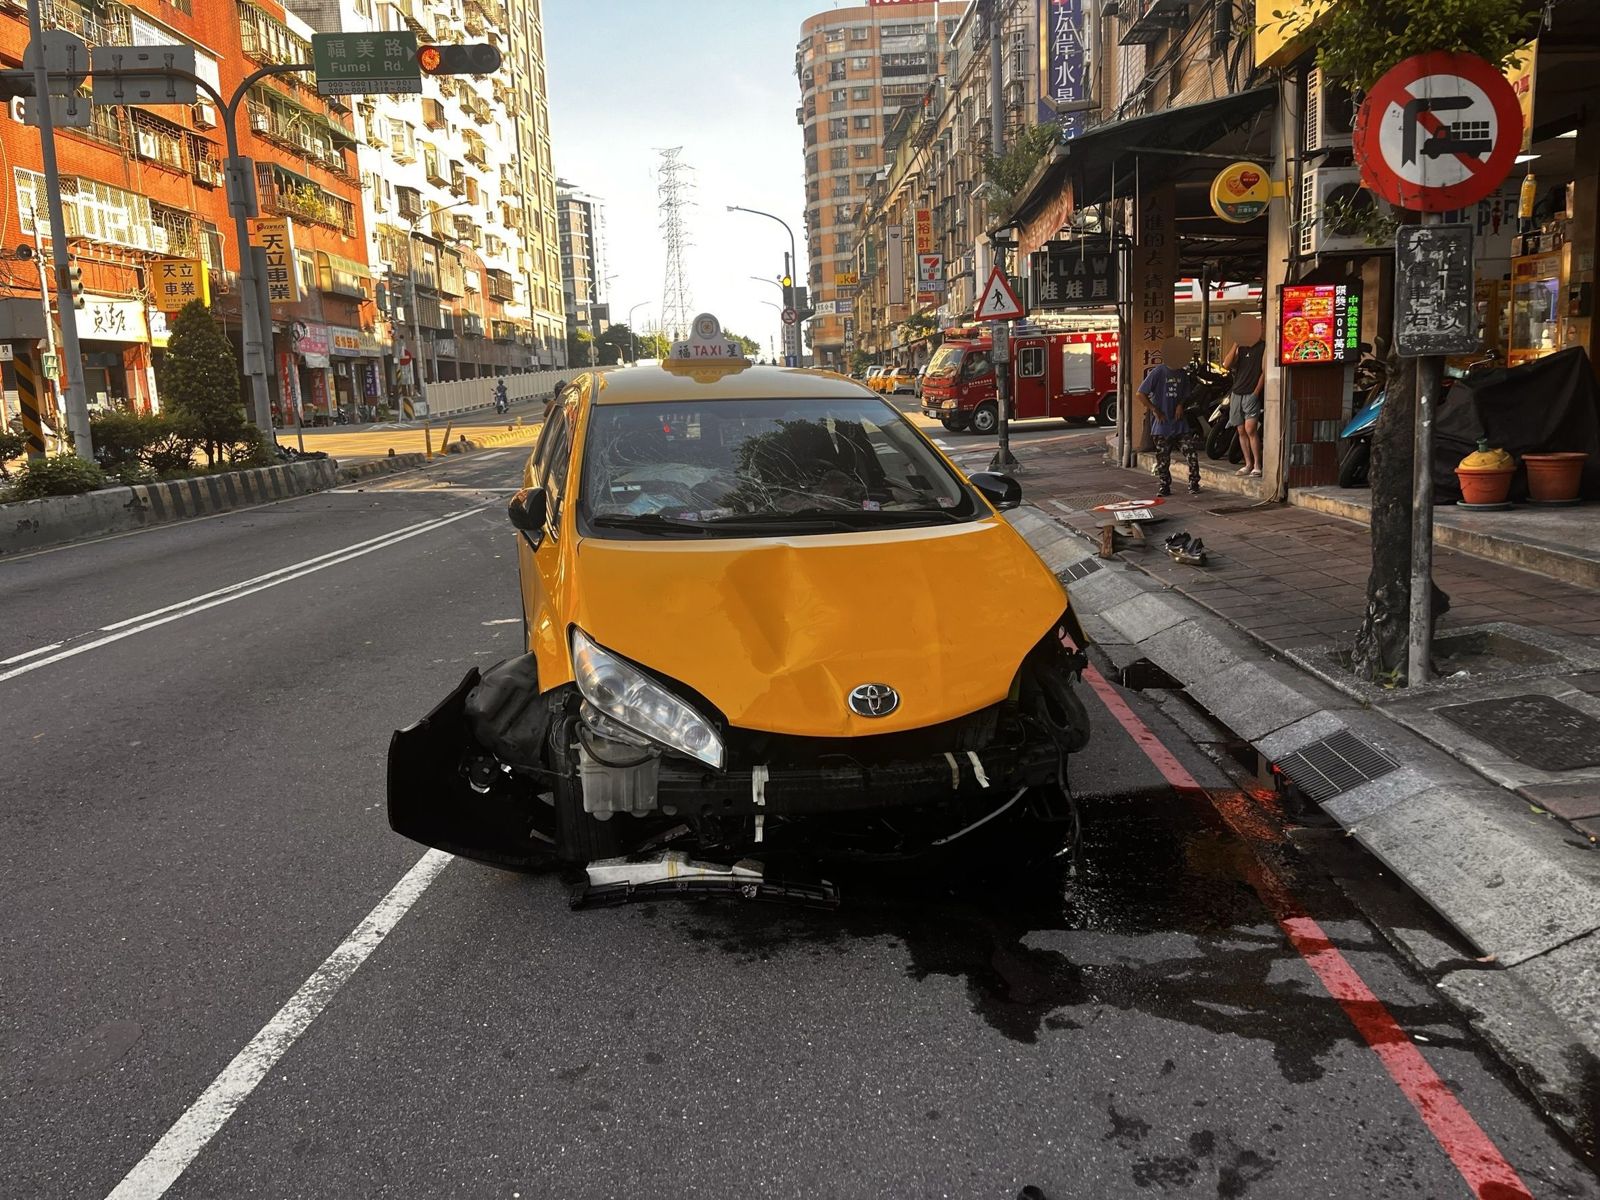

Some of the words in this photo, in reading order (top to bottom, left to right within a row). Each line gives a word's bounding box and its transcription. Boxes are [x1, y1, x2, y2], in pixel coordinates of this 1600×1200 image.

[326, 38, 403, 58] 福美路
[331, 62, 371, 73] Fumei
[384, 61, 404, 72] Rd.
[163, 263, 193, 278] 天立
[262, 234, 291, 299] 天立車業
[1042, 257, 1108, 278] CLAW
[164, 282, 195, 296] 車業
[1041, 279, 1108, 301] 娃娃屋
[678, 344, 691, 359] 福
[693, 345, 722, 356] TAXI
[726, 343, 738, 358] 星
